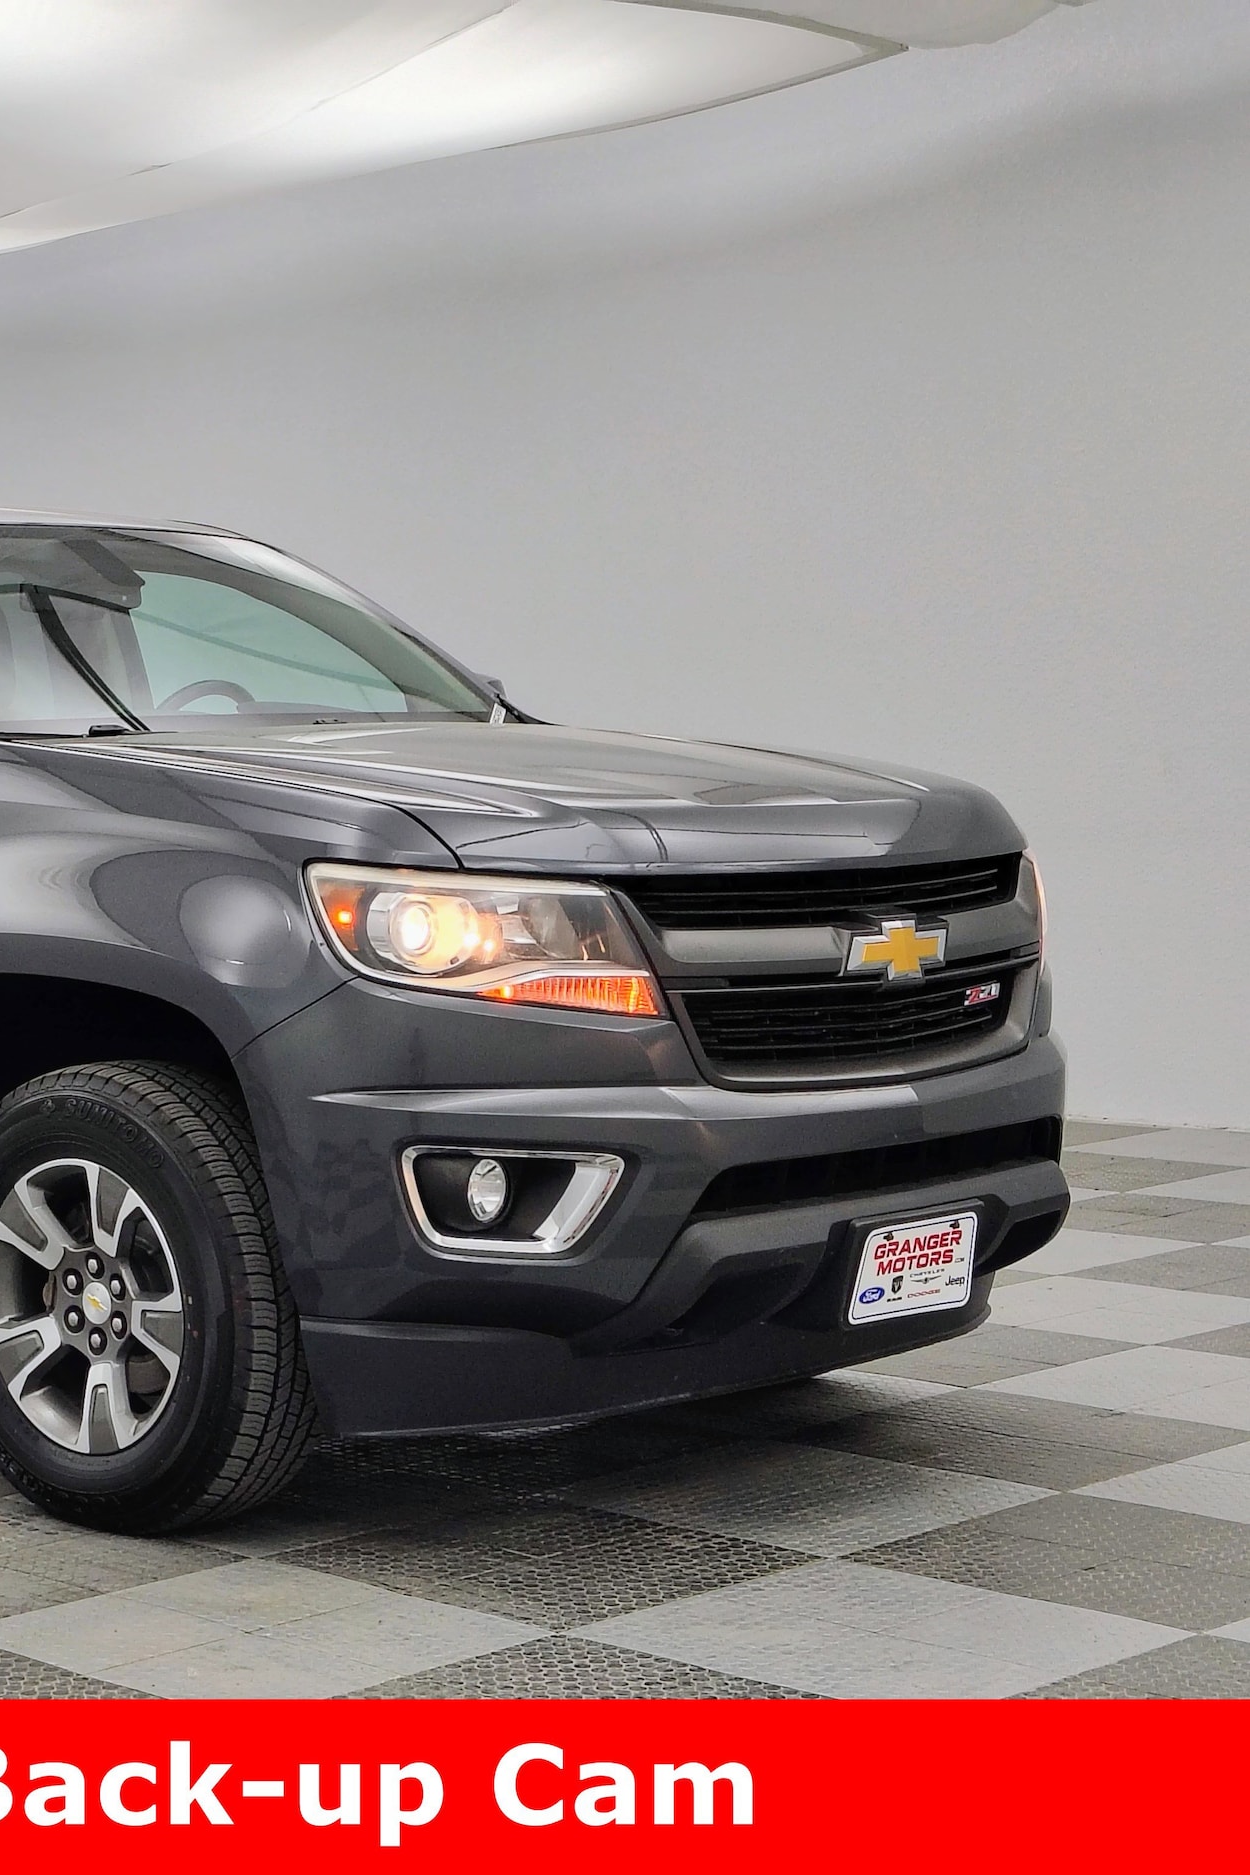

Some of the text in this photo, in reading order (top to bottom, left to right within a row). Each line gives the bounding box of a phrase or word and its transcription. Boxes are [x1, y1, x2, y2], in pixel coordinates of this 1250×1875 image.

[964, 983, 1000, 1006] Z71
[874, 1230, 963, 1260] GRANGER
[876, 1249, 954, 1276] MOTORS
[945, 1275, 965, 1287] Jeep
[861, 1289, 882, 1303] Ford
